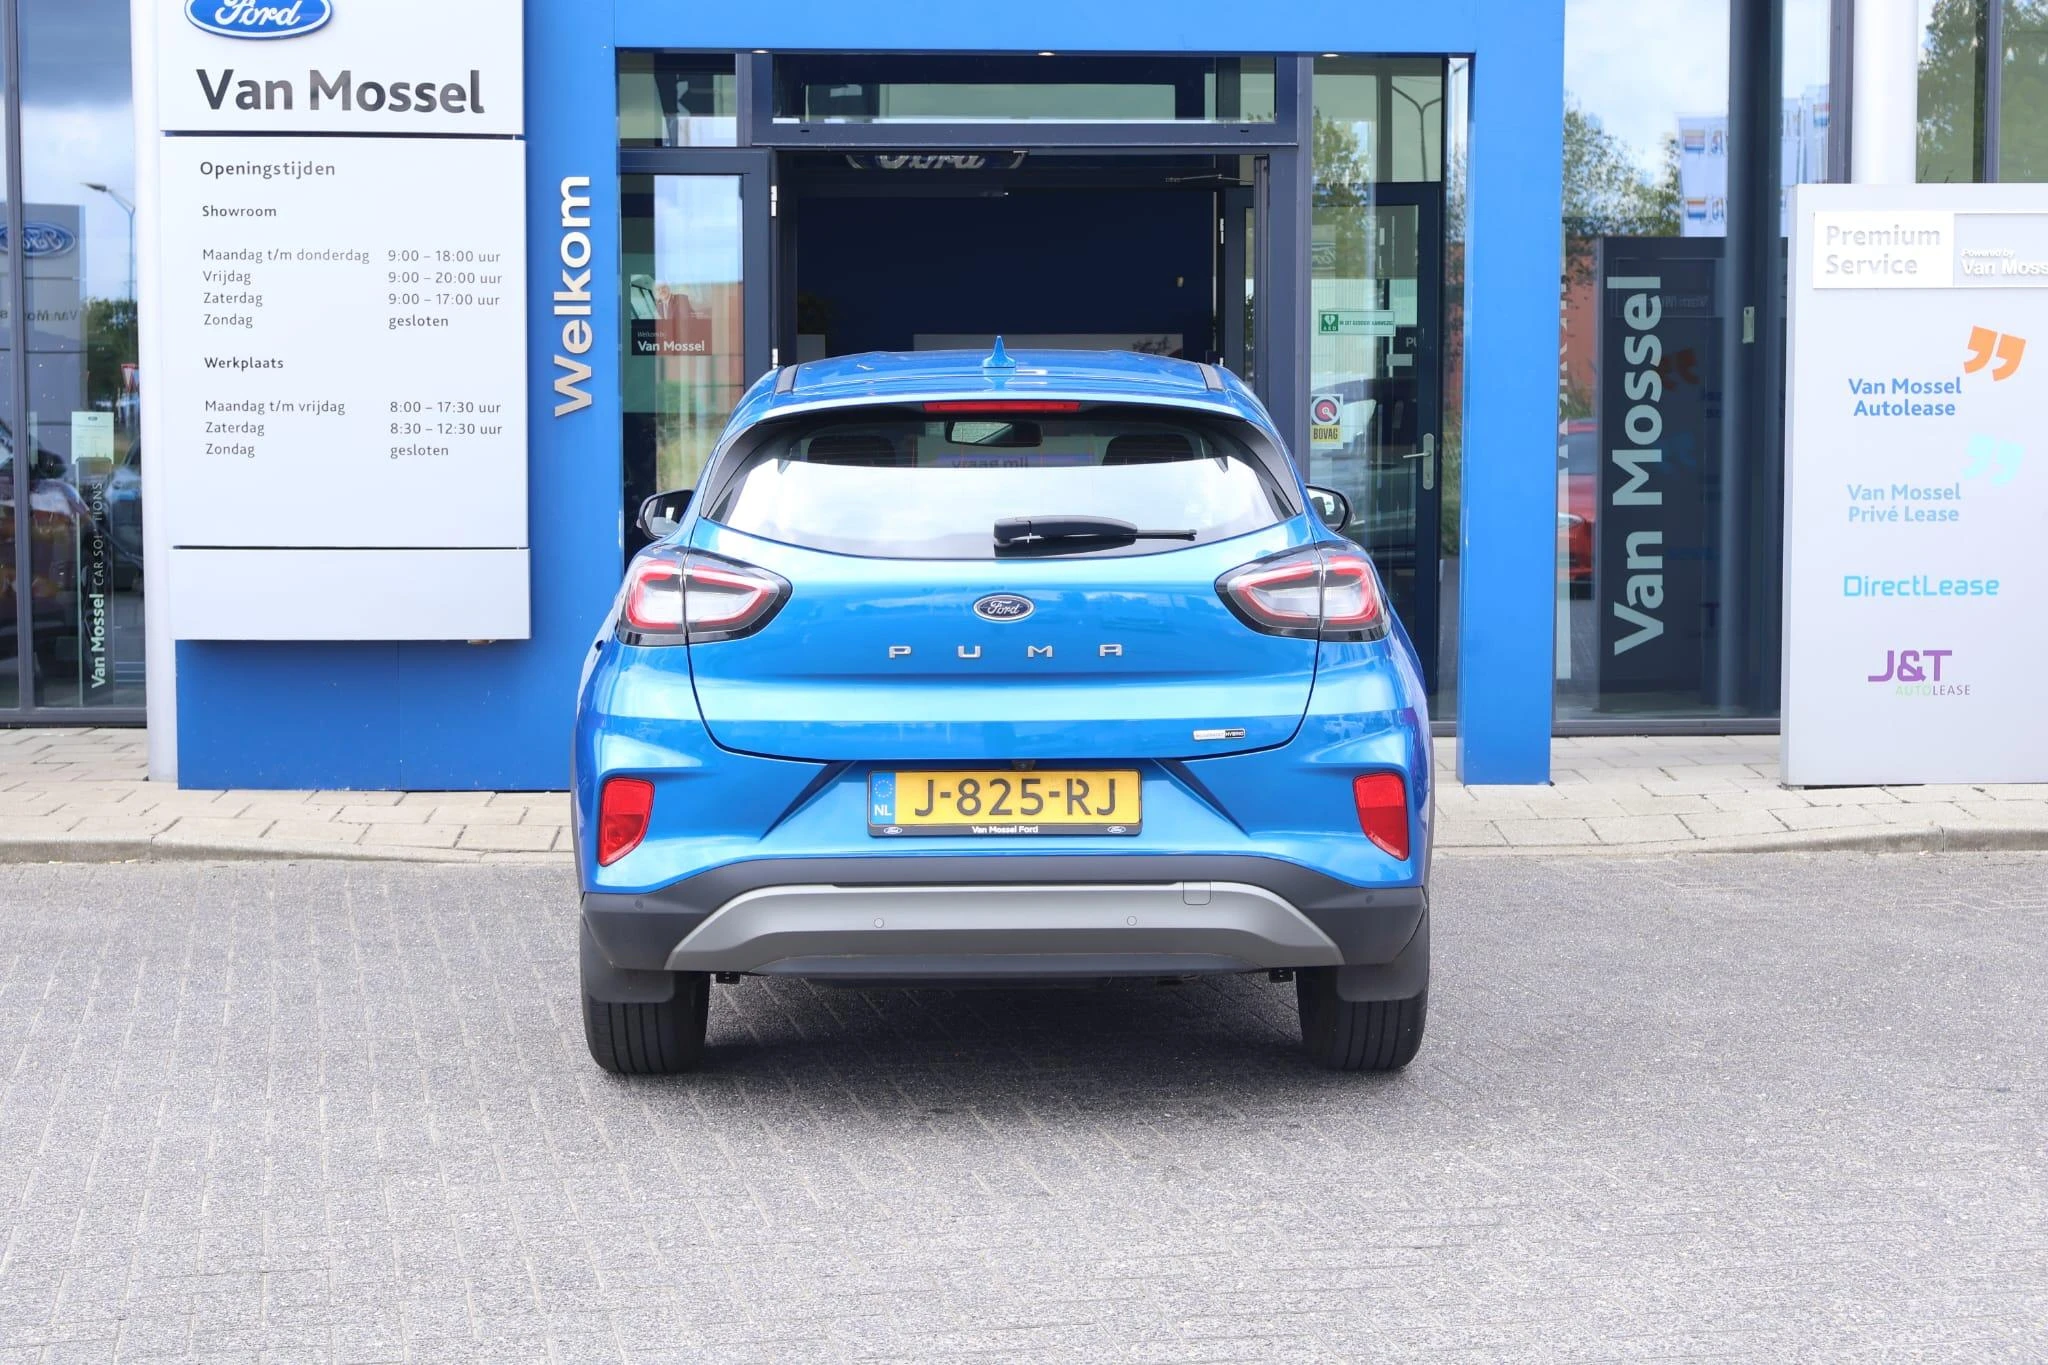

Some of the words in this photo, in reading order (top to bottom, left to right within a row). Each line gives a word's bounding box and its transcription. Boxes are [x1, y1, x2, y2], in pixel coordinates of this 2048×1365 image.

[215, 0, 301, 25] Ford
[196, 69, 293, 110] Van
[309, 69, 485, 113] Mossel
[200, 161, 336, 180] Openingstijden
[202, 205, 277, 217] Showroom
[1826, 224, 1940, 246] Premium
[203, 249, 263, 264] Maandag
[268, 249, 292, 260] t/m
[297, 249, 370, 264] donderdag
[388, 250, 419, 261] 9:00
[435, 250, 474, 262] 18:00
[479, 253, 501, 262] uur
[1826, 253, 1918, 275] Service
[1962, 258, 1996, 275] Van
[202, 270, 251, 285] Vrijdag
[388, 272, 419, 283] 9:00
[435, 272, 475, 284] 20:00
[480, 275, 503, 284] uur
[203, 292, 263, 307] Zaterdag
[388, 293, 420, 305] 9:00
[435, 293, 473, 305] 17:00
[478, 296, 501, 305] uur
[553, 176, 593, 417] Welkom
[204, 313, 253, 328] Zondag
[388, 314, 449, 330] gesloten
[638, 340, 660, 351] Van
[663, 341, 705, 351] Mossel
[204, 357, 284, 372] Werkplaats
[1607, 276, 1663, 505] Mossel
[1848, 378, 1886, 395] Van
[1891, 377, 1962, 395] Mossel
[205, 400, 265, 415] Maandag
[270, 400, 294, 412] t/m
[298, 400, 346, 416] vrijdag
[390, 401, 421, 413] 8:00
[437, 401, 474, 413] 17:30
[479, 404, 501, 413] uur
[1853, 399, 1956, 416] Autolease
[205, 421, 265, 437] Zaterdag
[390, 423, 421, 434] 8:30
[437, 423, 475, 434] 12:30
[480, 425, 502, 434] uur
[1313, 428, 1338, 439] BOVAG
[206, 443, 256, 458] Zondag
[390, 444, 449, 459] gesloten
[1847, 484, 1885, 501] Van
[1891, 482, 1961, 501] Mossel
[1848, 506, 1899, 522] Privé
[1904, 506, 1960, 522] Lease
[93, 562, 104, 586] CAR
[1613, 530, 1664, 656] Van
[1843, 575, 2000, 597] DirectLease
[89, 594, 105, 651] Mossel
[889, 644, 1123, 658] PUMA
[91, 656, 105, 689] Van
[1868, 650, 1953, 682] J&T
[1895, 685, 1971, 696] AUTOLEASE
[874, 804, 892, 816] NL
[915, 778, 1116, 816] J-825-RJ
